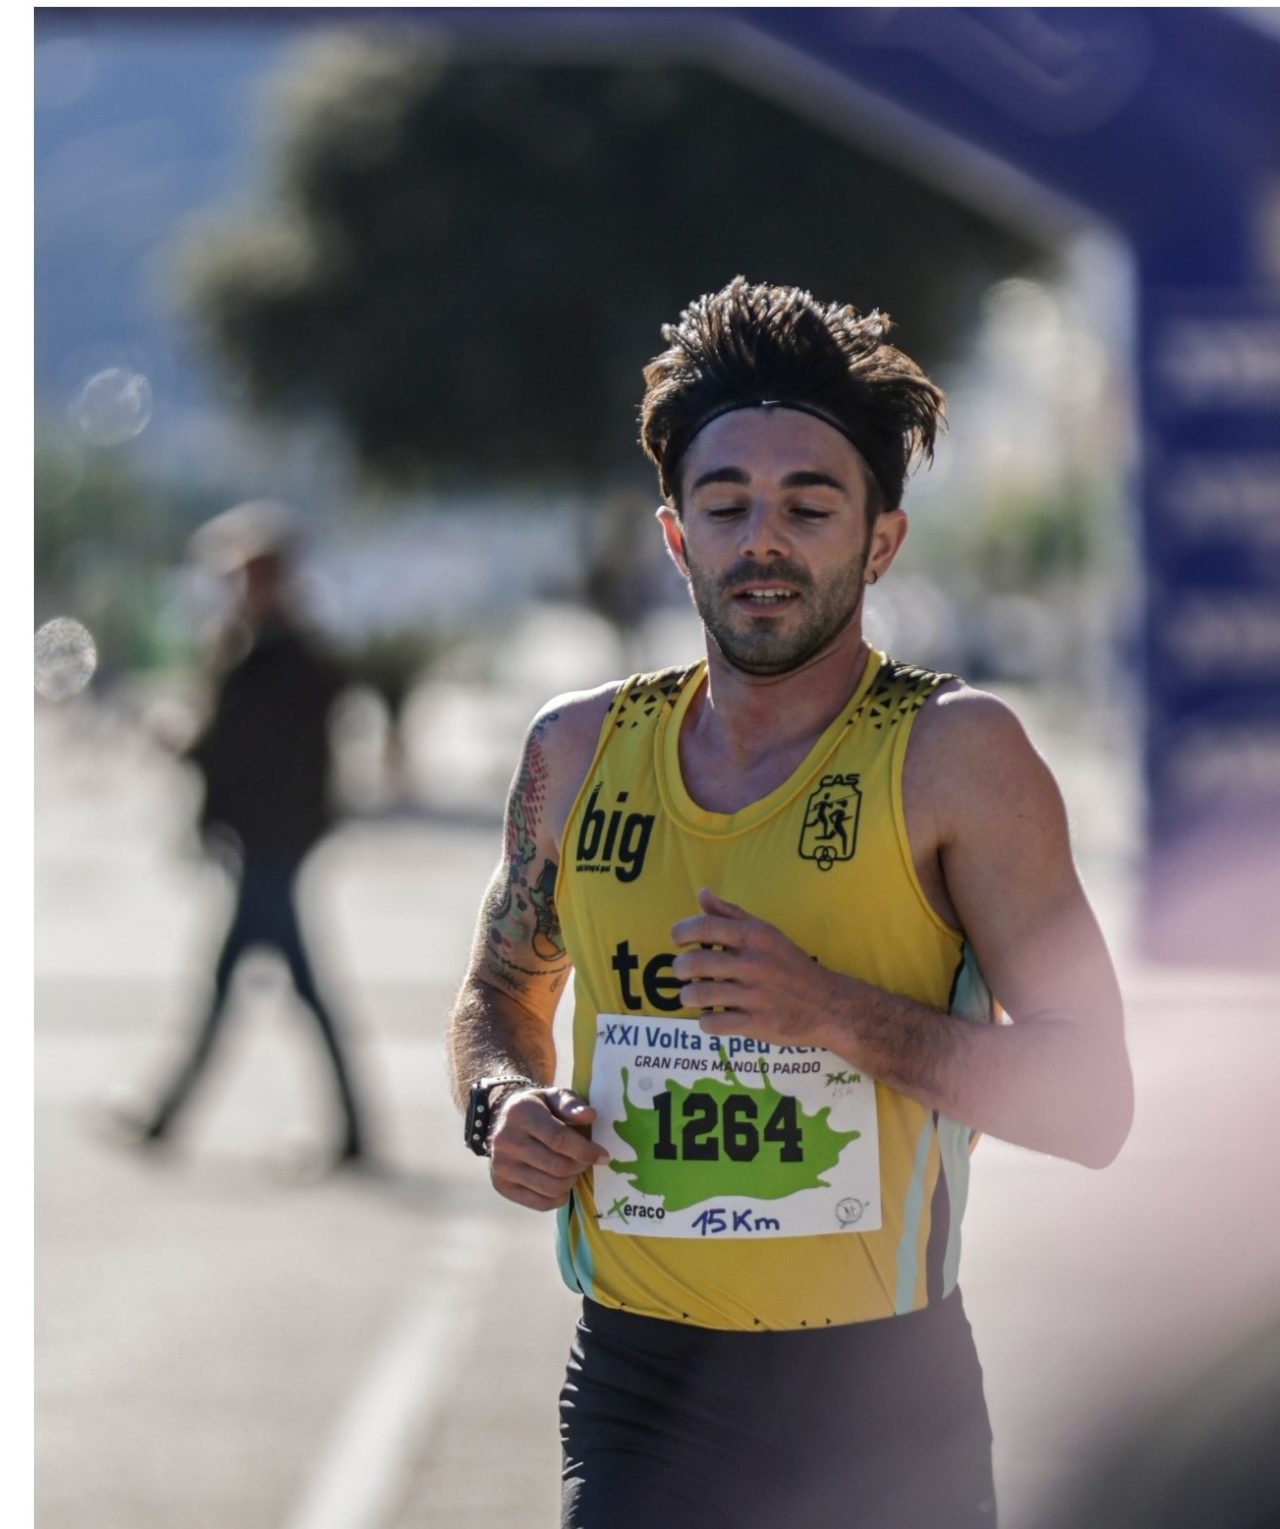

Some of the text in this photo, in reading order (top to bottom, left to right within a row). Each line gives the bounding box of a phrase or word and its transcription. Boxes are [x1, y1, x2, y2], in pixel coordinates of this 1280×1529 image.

[819, 773, 861, 787] CAS
[576, 781, 656, 883] big
[604, 1024, 770, 1058] XXI Volta a peu
[634, 1056, 821, 1075] GRAN FONS MANOLO PARDO
[652, 1092, 804, 1163] 1264
[607, 1196, 666, 1225] Xeraco
